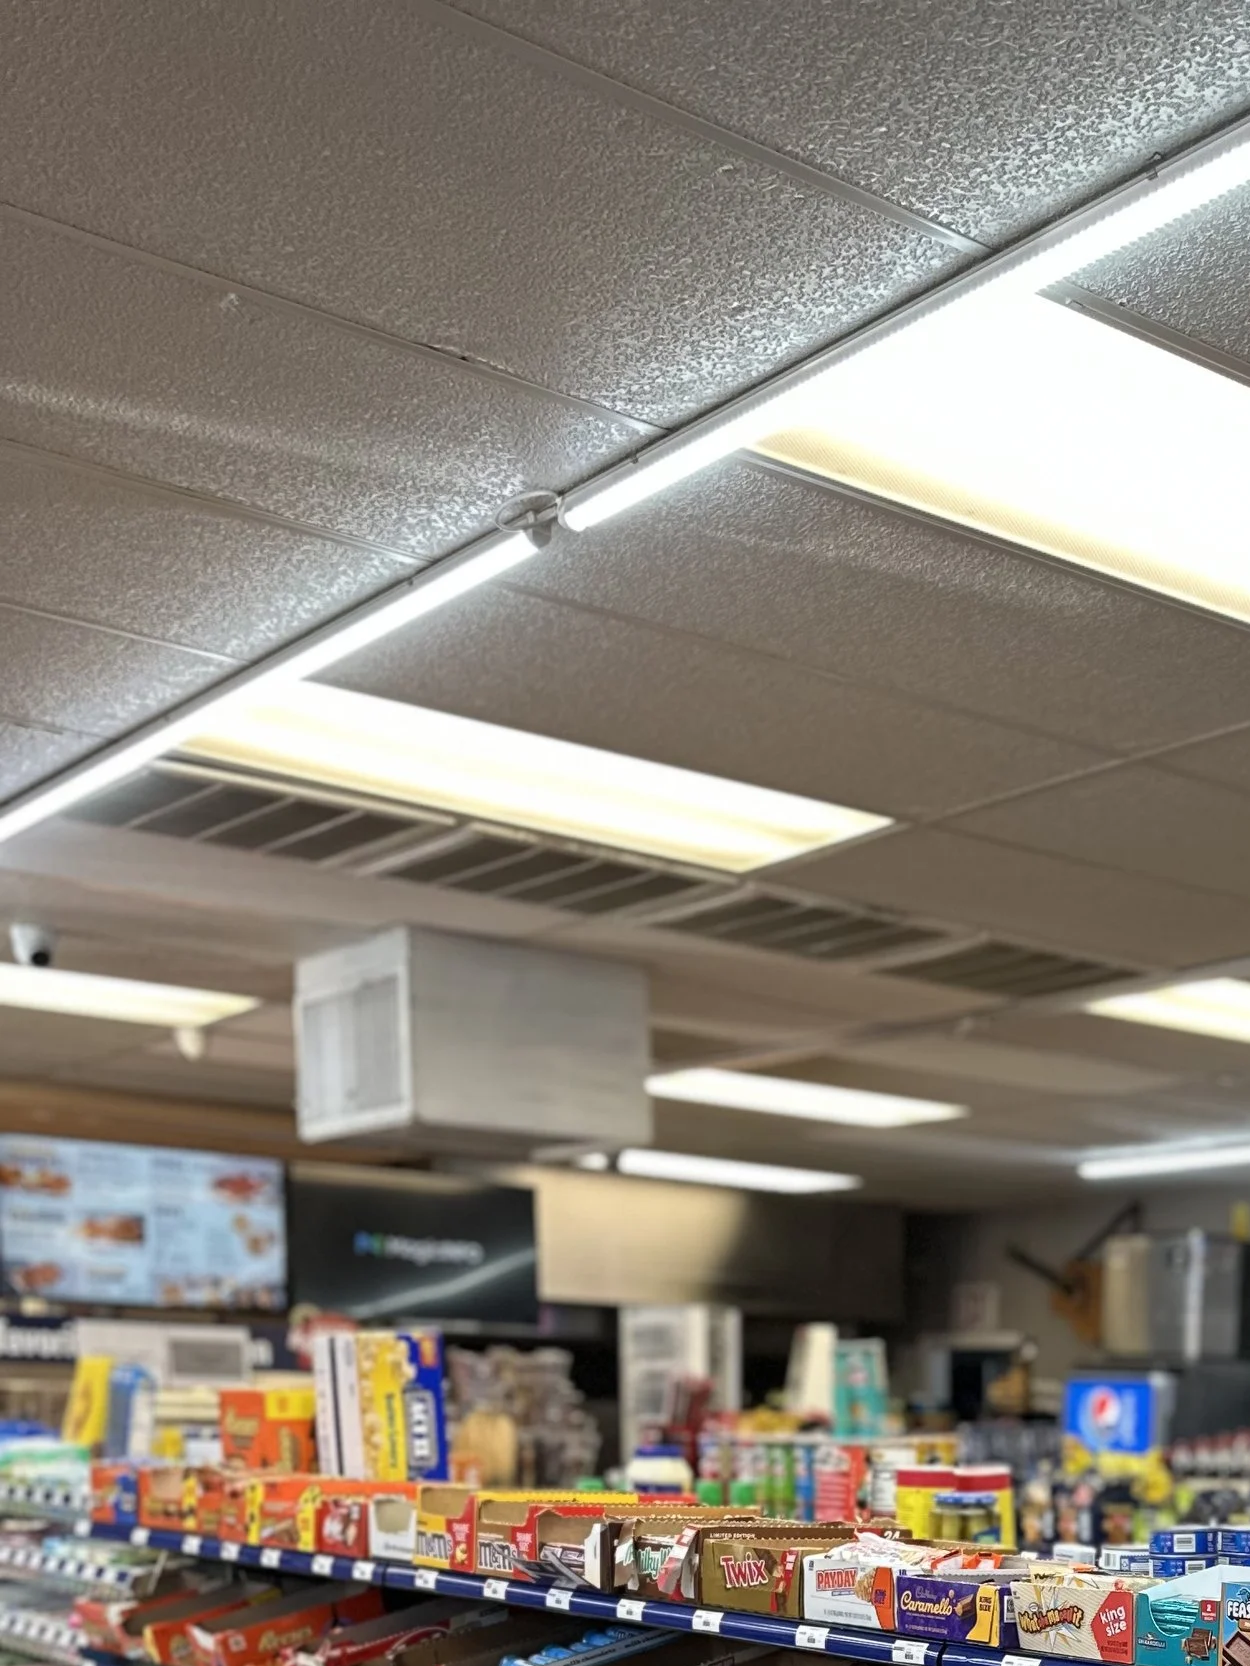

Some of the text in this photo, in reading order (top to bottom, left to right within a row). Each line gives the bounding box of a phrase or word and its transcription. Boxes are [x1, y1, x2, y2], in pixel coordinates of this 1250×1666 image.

[900, 1590, 952, 1616] Caramello
[1100, 1605, 1126, 1624] king
[1105, 1619, 1127, 1637] size
